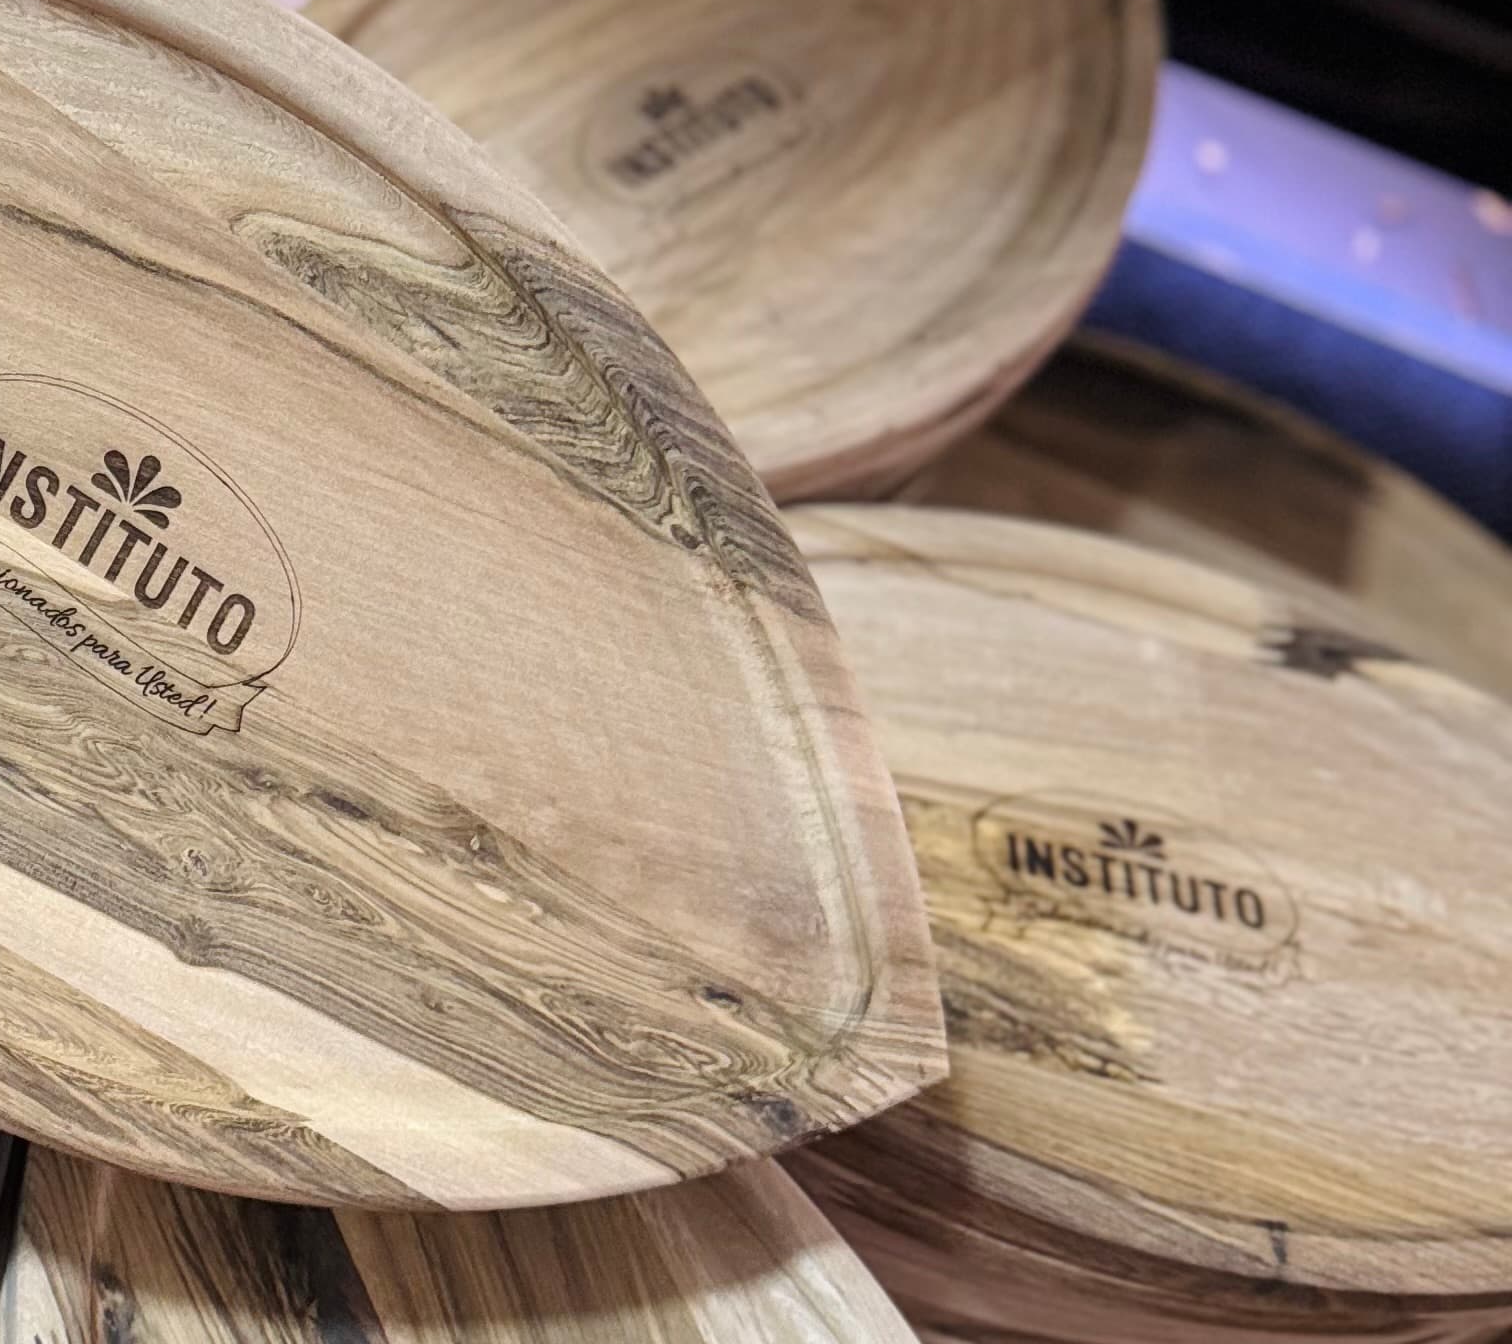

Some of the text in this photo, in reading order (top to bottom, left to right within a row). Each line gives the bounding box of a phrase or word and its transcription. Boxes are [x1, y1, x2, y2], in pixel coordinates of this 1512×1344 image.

[70, 632, 133, 676] para
[134, 666, 218, 719] Usted!
[1005, 832, 1266, 930] INSTITUTO
